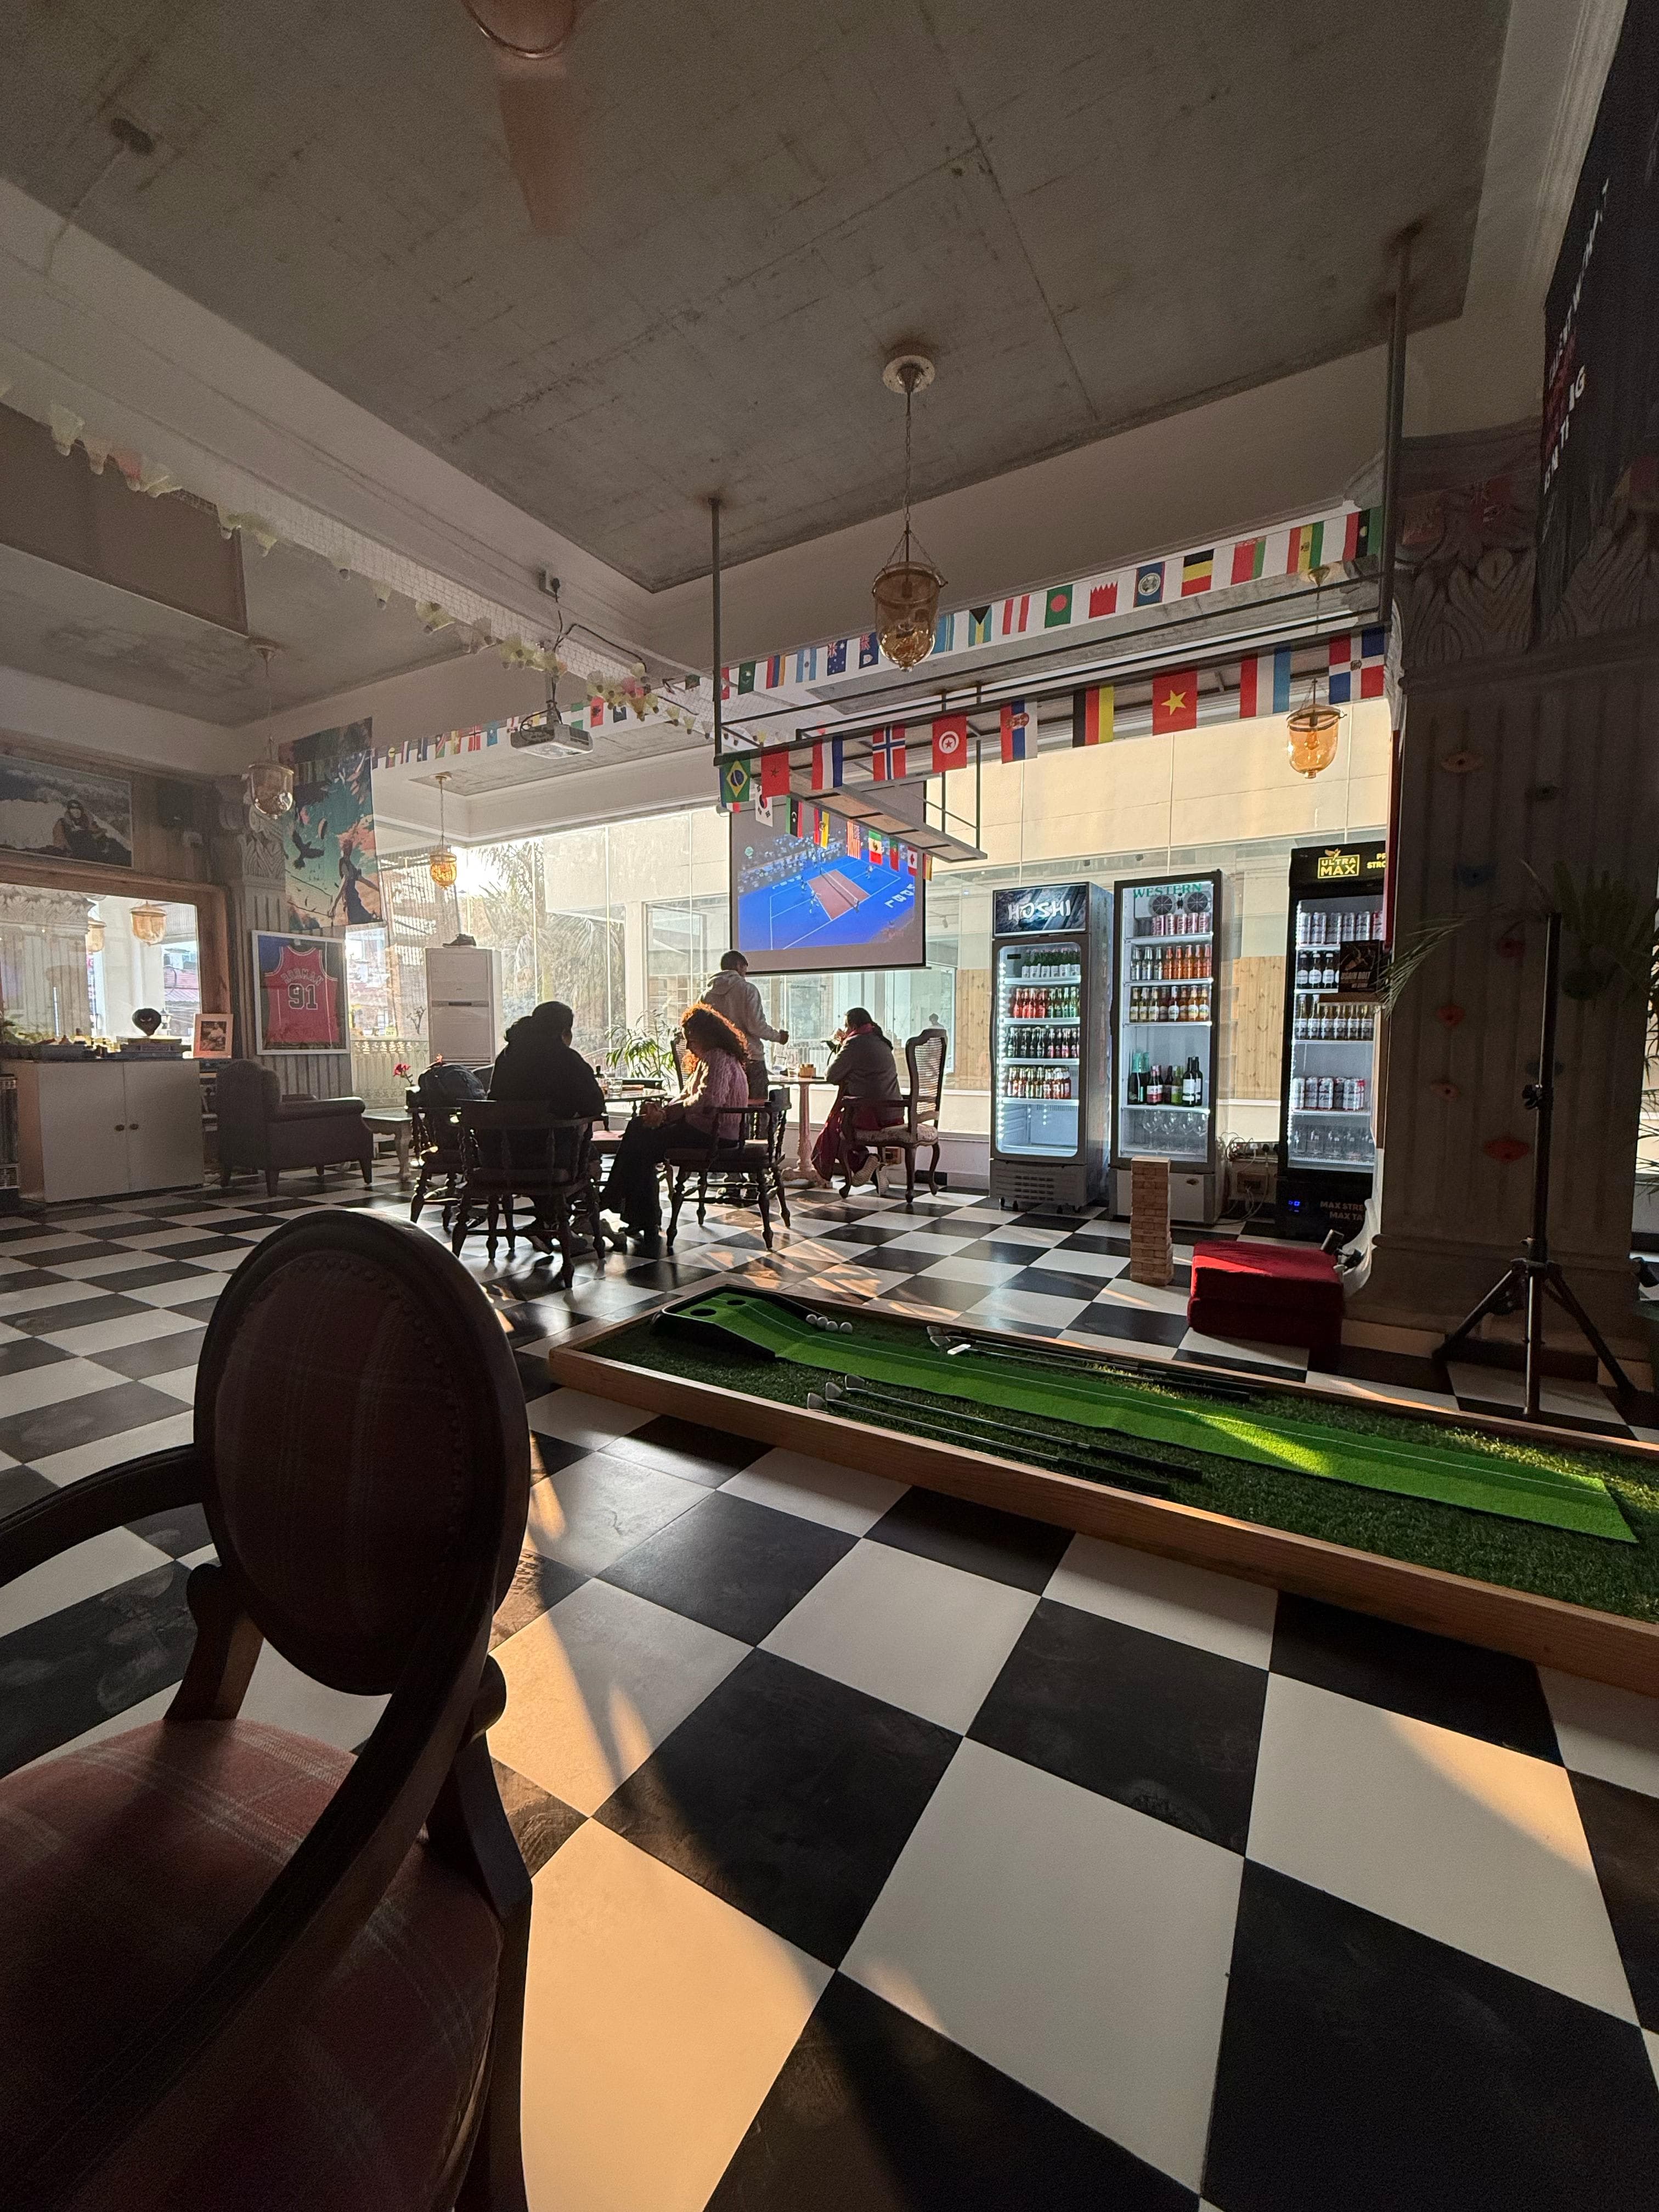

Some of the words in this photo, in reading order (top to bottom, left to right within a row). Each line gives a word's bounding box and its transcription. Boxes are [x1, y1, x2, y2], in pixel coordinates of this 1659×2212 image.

[1321, 857, 1356, 867] ULTRA
[1321, 865, 1356, 876] MAX
[1133, 883, 1202, 899] WESTERN
[1008, 899, 1071, 920] HOSHI
[287, 983, 318, 1011] 91
[1321, 1201, 1340, 1209] MAX
[1329, 1211, 1351, 1220] MAX
